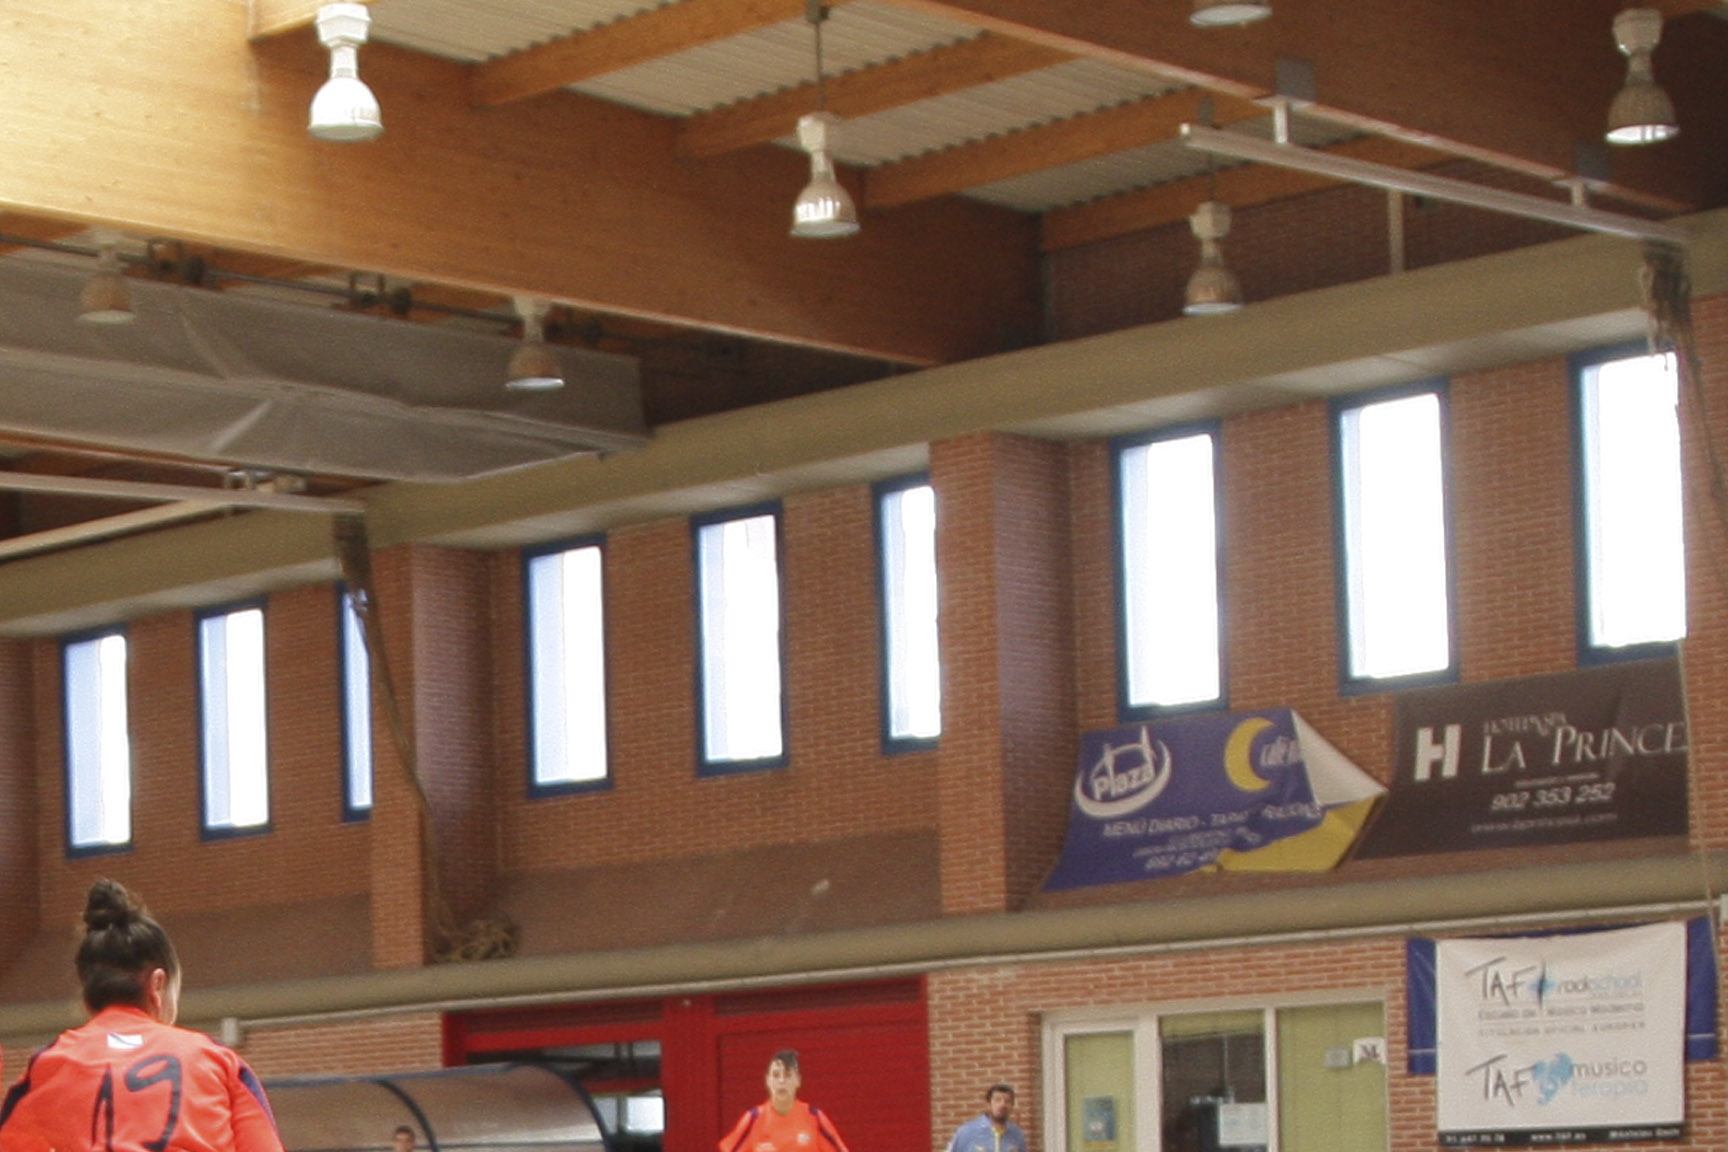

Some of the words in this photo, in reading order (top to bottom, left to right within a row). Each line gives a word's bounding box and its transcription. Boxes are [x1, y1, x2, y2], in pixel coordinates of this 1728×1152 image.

[1414, 723, 1462, 783] H
[1481, 735, 1527, 773] LA
[1532, 785, 1573, 807] 353
[1465, 956, 1536, 1006] TAF
[1466, 1054, 1537, 1107] TAF
